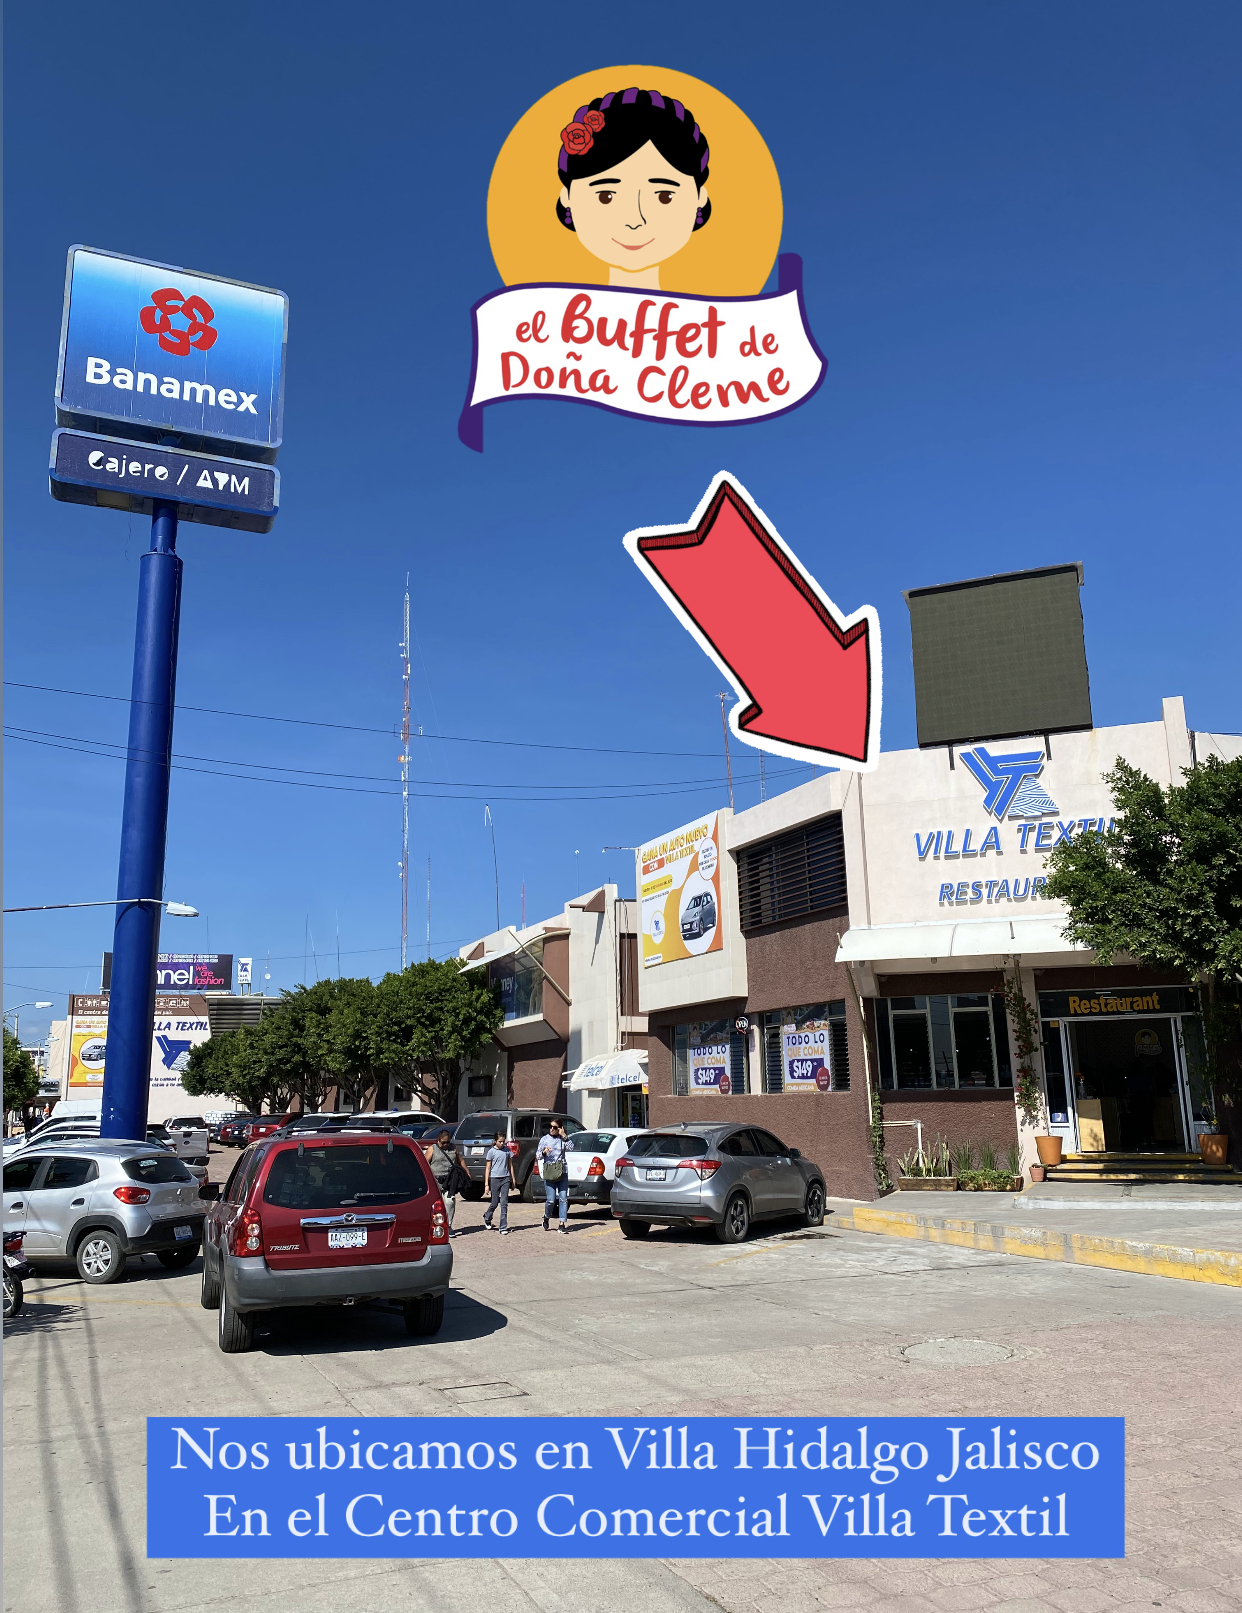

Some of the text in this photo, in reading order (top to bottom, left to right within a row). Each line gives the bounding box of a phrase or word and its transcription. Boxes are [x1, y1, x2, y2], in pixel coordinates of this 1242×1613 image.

[85, 356, 258, 415] Banamex
[88, 451, 168, 480] Cajero
[196, 469, 249, 495] ATM
[642, 823, 709, 863] GANA UN AUTO NUEVO
[914, 826, 1003, 860] VILLA
[648, 861, 659, 872] CON
[194, 976, 224, 985] fashion
[1068, 992, 1160, 1014] Restaurant
[176, 1021, 209, 1031] TEXTIL
[786, 1033, 825, 1046] TODO LO
[693, 1045, 727, 1056] TODO LO
[787, 1045, 825, 1059] QUE COMA
[693, 1055, 727, 1067] QUE COMA
[617, 1072, 640, 1084] telcel
